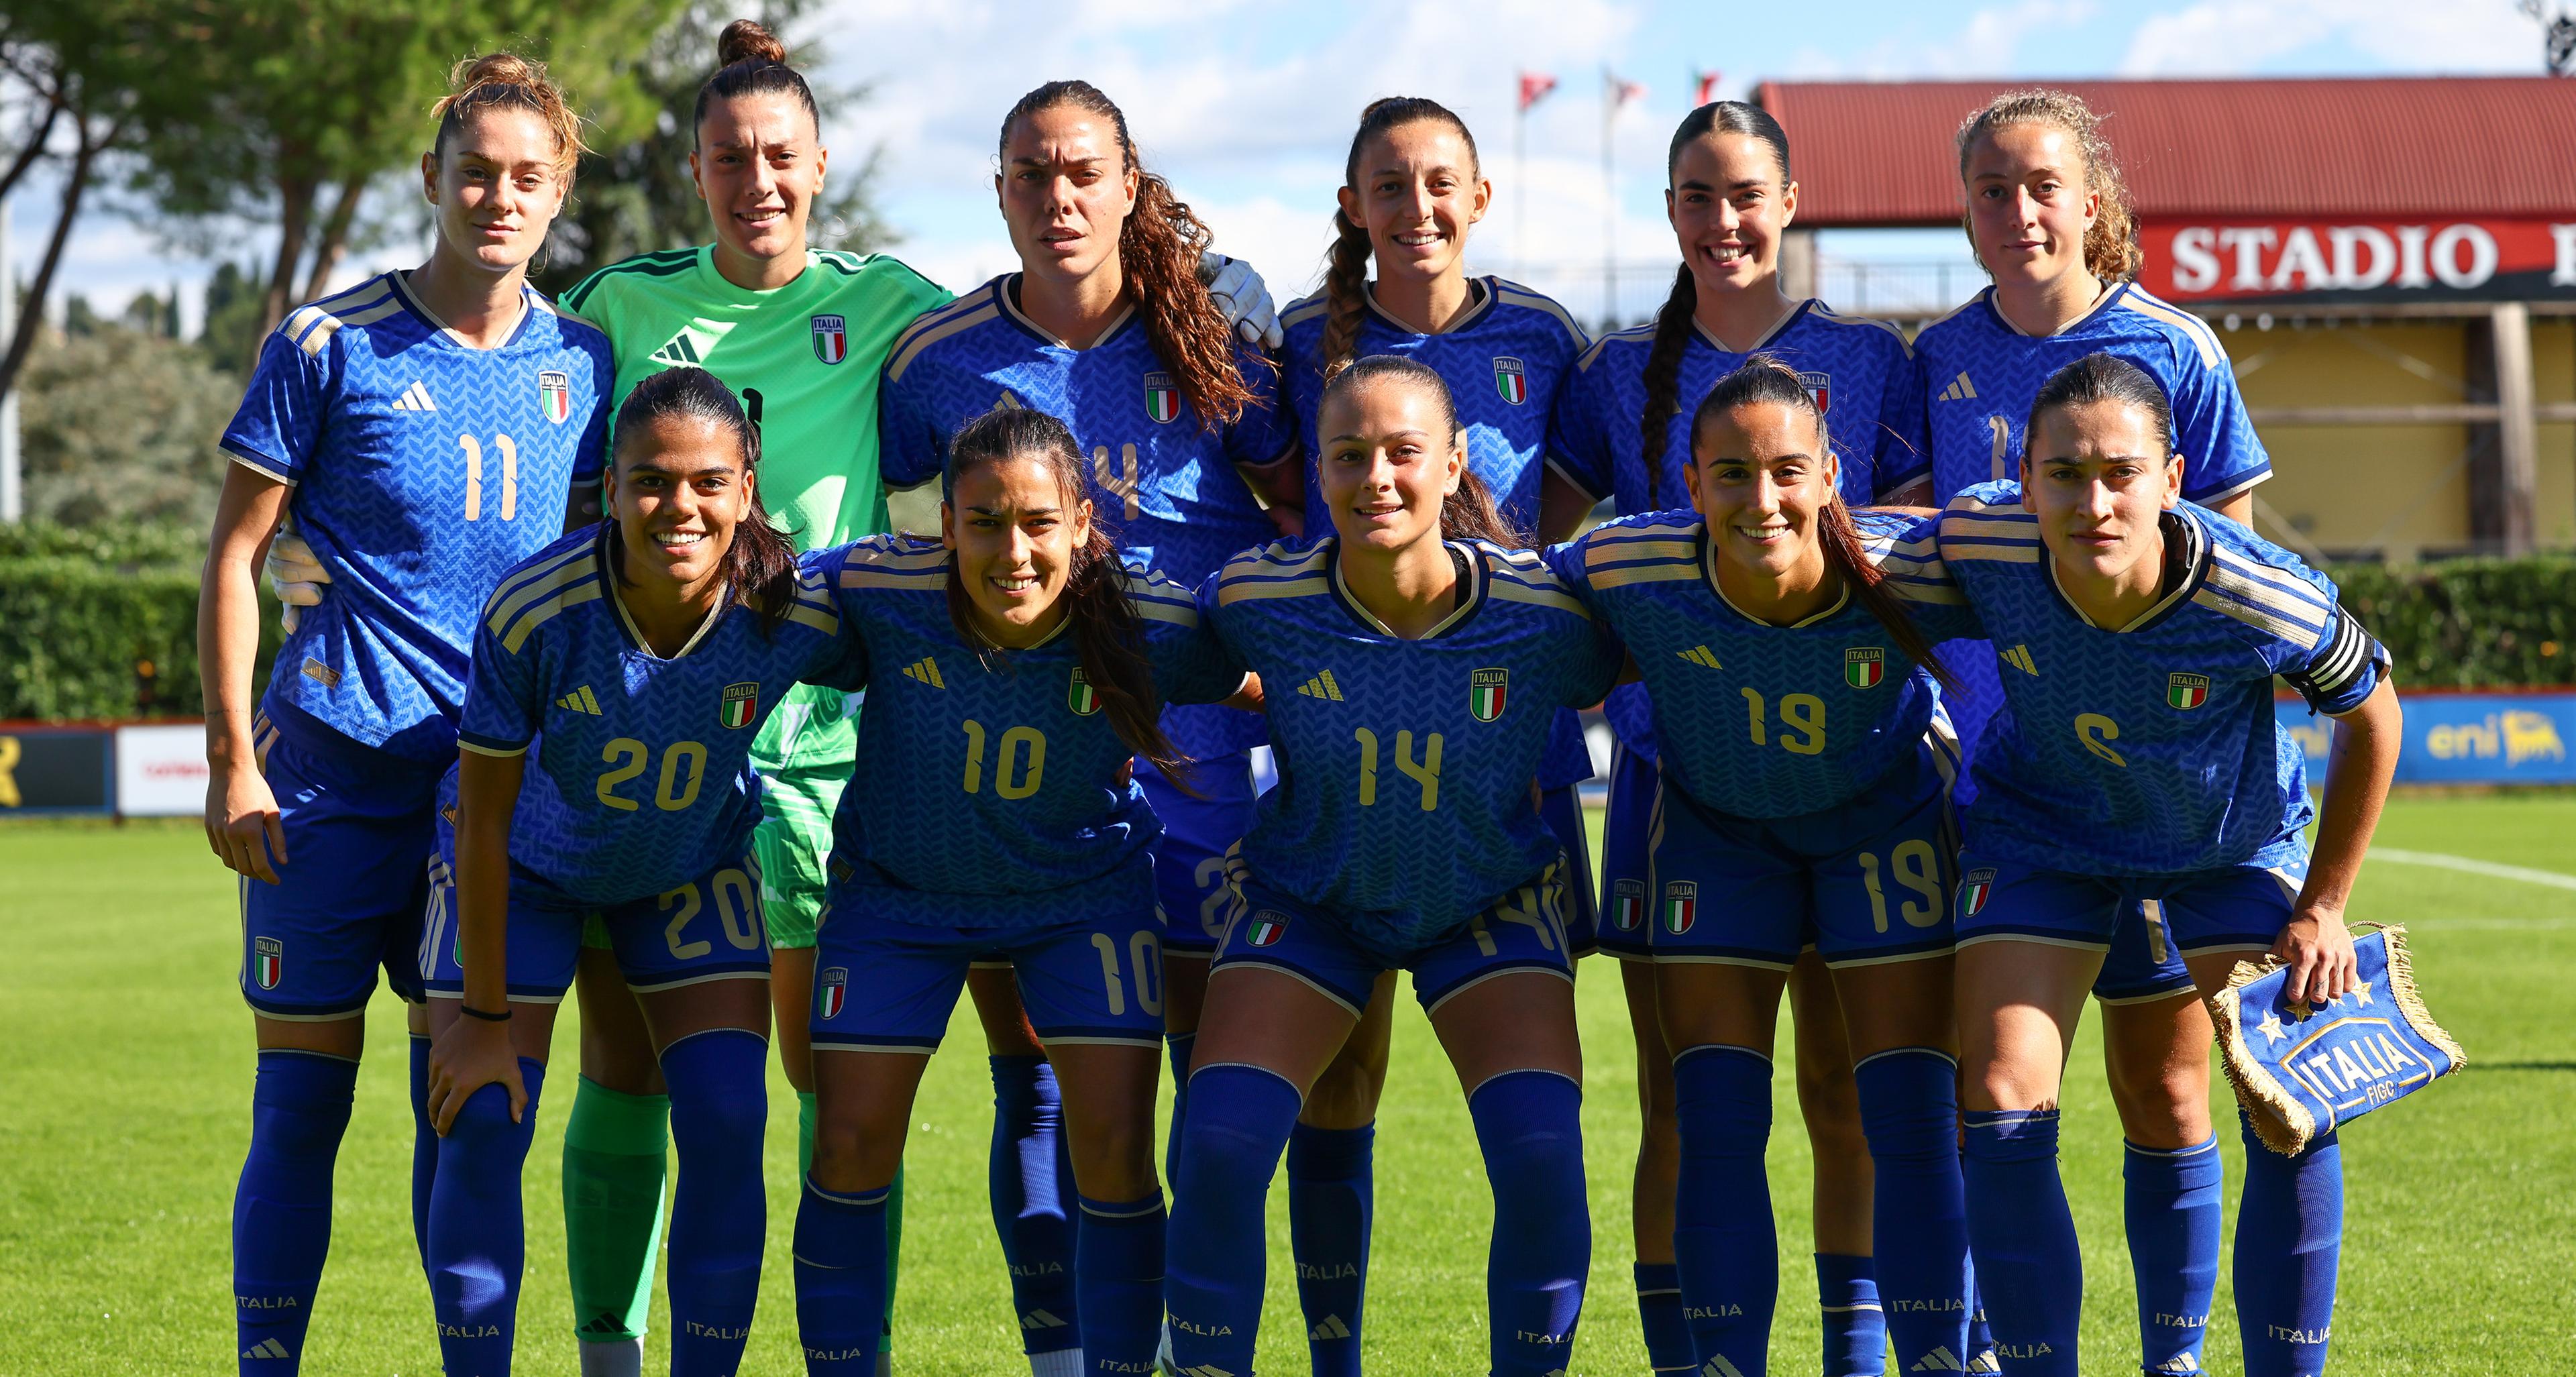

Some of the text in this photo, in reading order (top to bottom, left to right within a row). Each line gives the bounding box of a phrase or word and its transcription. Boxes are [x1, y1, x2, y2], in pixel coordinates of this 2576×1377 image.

[2171, 223, 2499, 291] STADIO
[814, 319, 842, 329] ITALIA
[1496, 360, 1521, 371] ITALIA
[541, 374, 566, 387] ITALIA
[460, 434, 517, 521] 11
[1849, 650, 1880, 659] ITALIA
[1474, 672, 1505, 683] ITALIA
[2173, 675, 2205, 685] ITALIA
[726, 686, 755, 698] ITALIA
[1741, 687, 1825, 755] 19
[2288, 717, 2328, 759] ni
[2426, 713, 2500, 759] eni
[963, 719, 1046, 800] 10
[596, 738, 708, 811] 20
[1355, 727, 1444, 811] 14
[1969, 871, 1992, 882] ITALIA
[1616, 883, 1641, 894] ITALIA
[1668, 885, 1693, 895] ITALIA
[1858, 839, 1943, 933] 19
[658, 869, 760, 960] 20
[1256, 912, 1287, 924] ITALIA
[257, 940, 279, 953] ITALIA
[823, 971, 844, 982] ITALIA
[1091, 930, 1162, 1016] 10
[2298, 1033, 2416, 1099] ITALIA
[2366, 1080, 2395, 1105] FIGC
[1008, 1262, 1063, 1276] TALIA
[236, 1295, 297, 1309] ITALIA
[1892, 1299, 1965, 1313] ITALIA
[1682, 1304, 1742, 1320] ITALIA
[437, 1322, 499, 1337] TALIA
[686, 1321, 749, 1339] ITALIA
[1517, 1330, 1574, 1344] ITALI
[1992, 1339, 2052, 1358] TALIA
